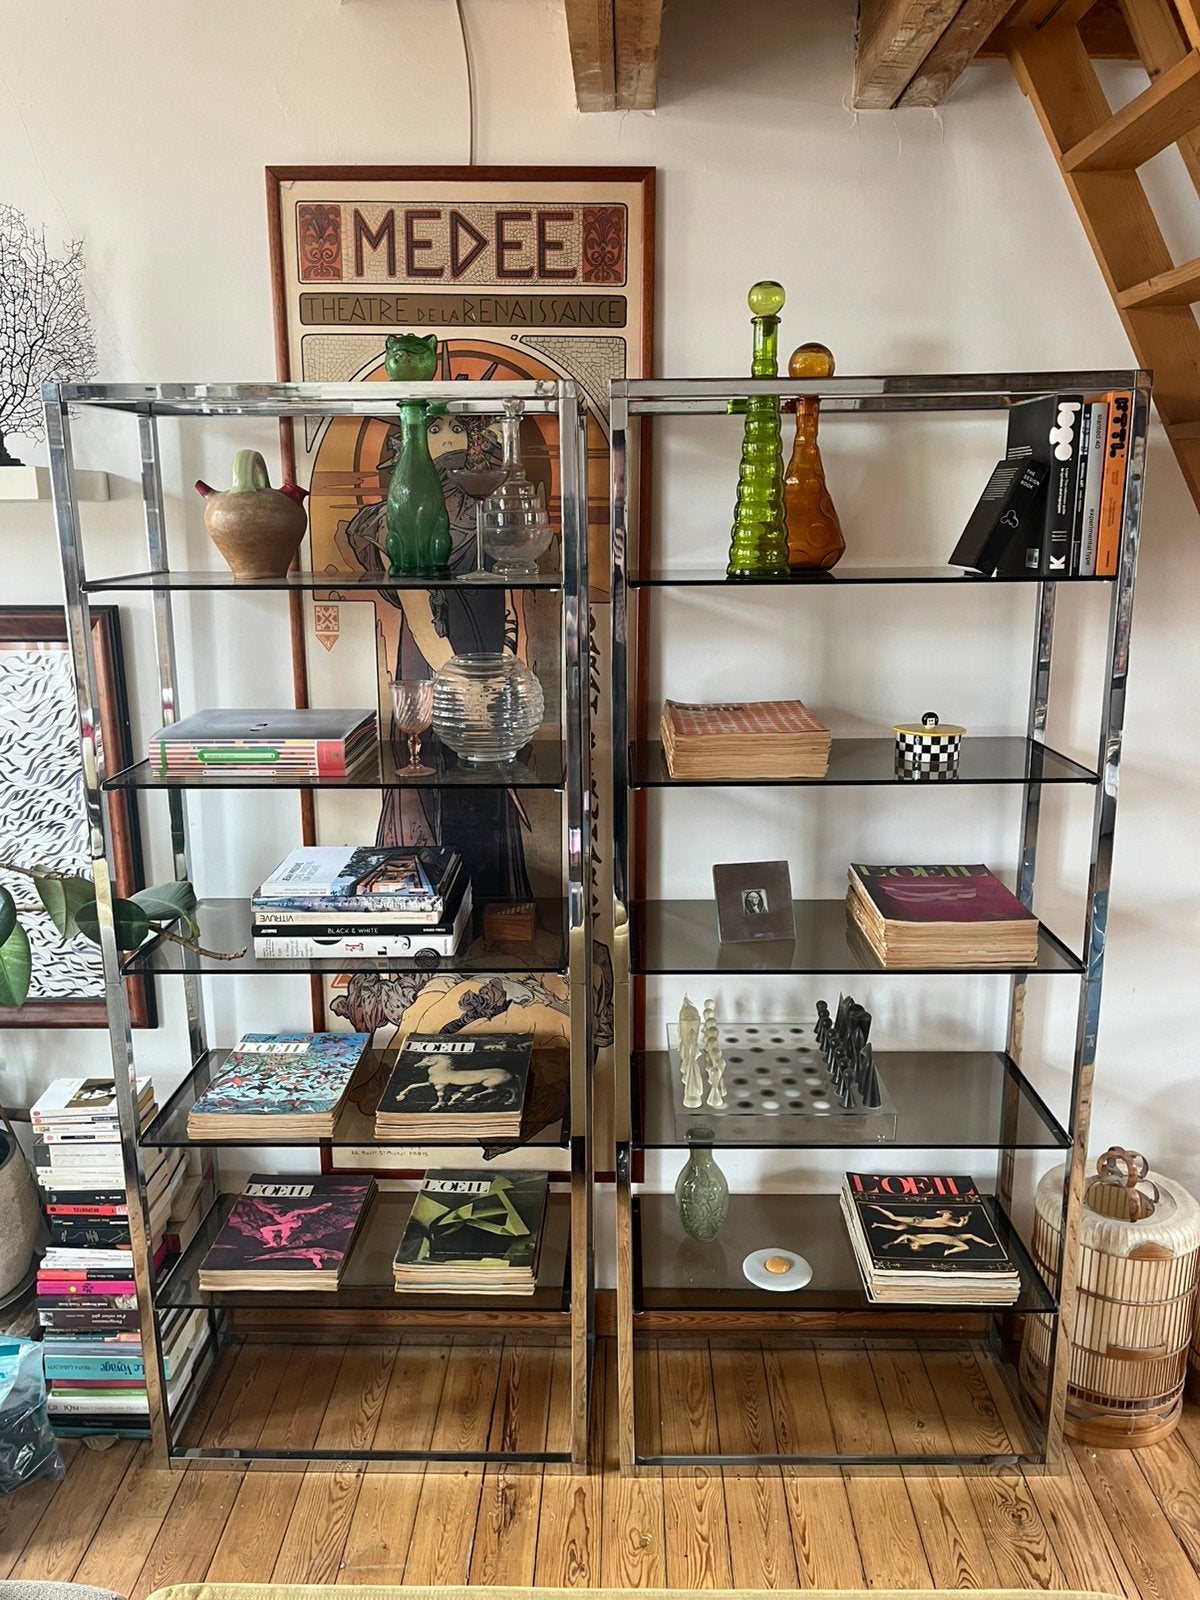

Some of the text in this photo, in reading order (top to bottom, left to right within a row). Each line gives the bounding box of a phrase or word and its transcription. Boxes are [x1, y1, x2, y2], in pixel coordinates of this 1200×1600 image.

[354, 207, 578, 279] MEDEE
[305, 297, 408, 322] THEATRE
[463, 298, 622, 323] RENAISSANCE
[1095, 414, 1103, 439] slanted
[1020, 480, 1034, 490] BOOK
[1023, 474, 1040, 486] DESIGN
[1086, 508, 1095, 551] experimental
[1085, 551, 1093, 566] type
[260, 914, 294, 923] VITRUVE
[327, 927, 350, 935] BLACK
[358, 927, 379, 935] WHITE
[100, 1361, 133, 1375] Voyage
